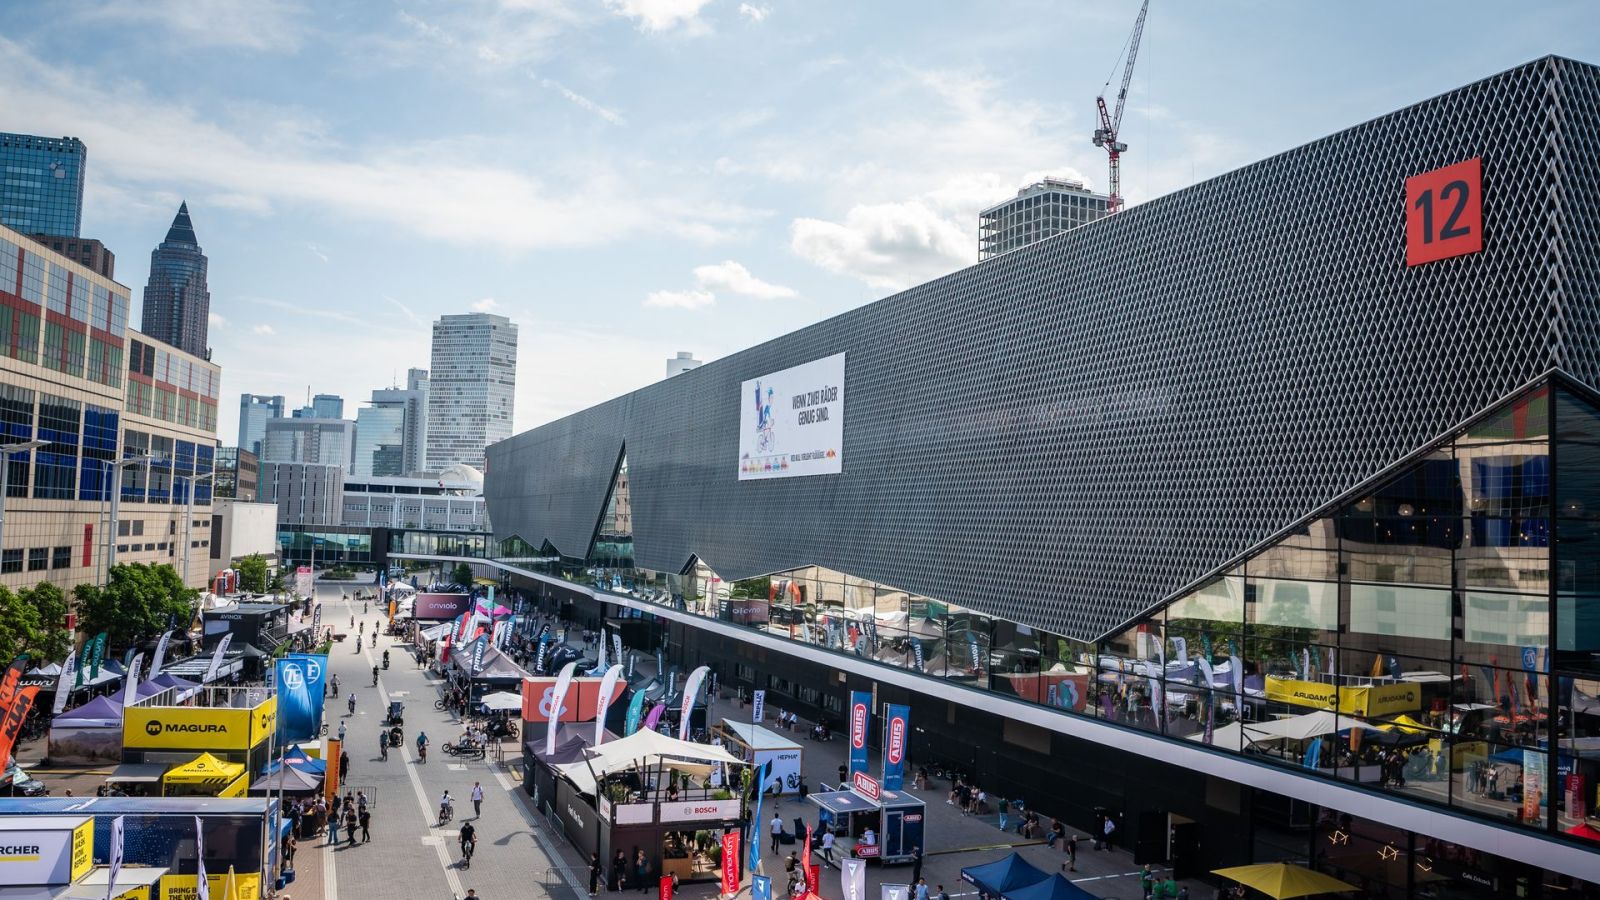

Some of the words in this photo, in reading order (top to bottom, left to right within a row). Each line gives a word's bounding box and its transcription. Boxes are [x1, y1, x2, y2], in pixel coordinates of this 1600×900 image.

[1415, 180, 1470, 244] 12
[792, 394, 806, 409] WENN
[807, 391, 820, 406] ZWEI
[821, 385, 838, 403] RÄDER
[798, 409, 815, 425] GENUG
[429, 602, 457, 610] enviolo
[451, 620, 461, 644] pinion
[504, 621, 514, 646] pinion
[474, 641, 485, 672] pinion
[537, 642, 546, 671] pinion
[285, 669, 301, 684] ZF
[5, 695, 31, 740] KTM
[598, 696, 606, 715] BOSCH
[165, 724, 227, 733] MAGURA
[854, 708, 865, 740] ABUS
[891, 722, 902, 758] ABUS
[856, 775, 877, 796] ABUS
[860, 847, 879, 855] ABUS
[727, 836, 736, 892] momentum
